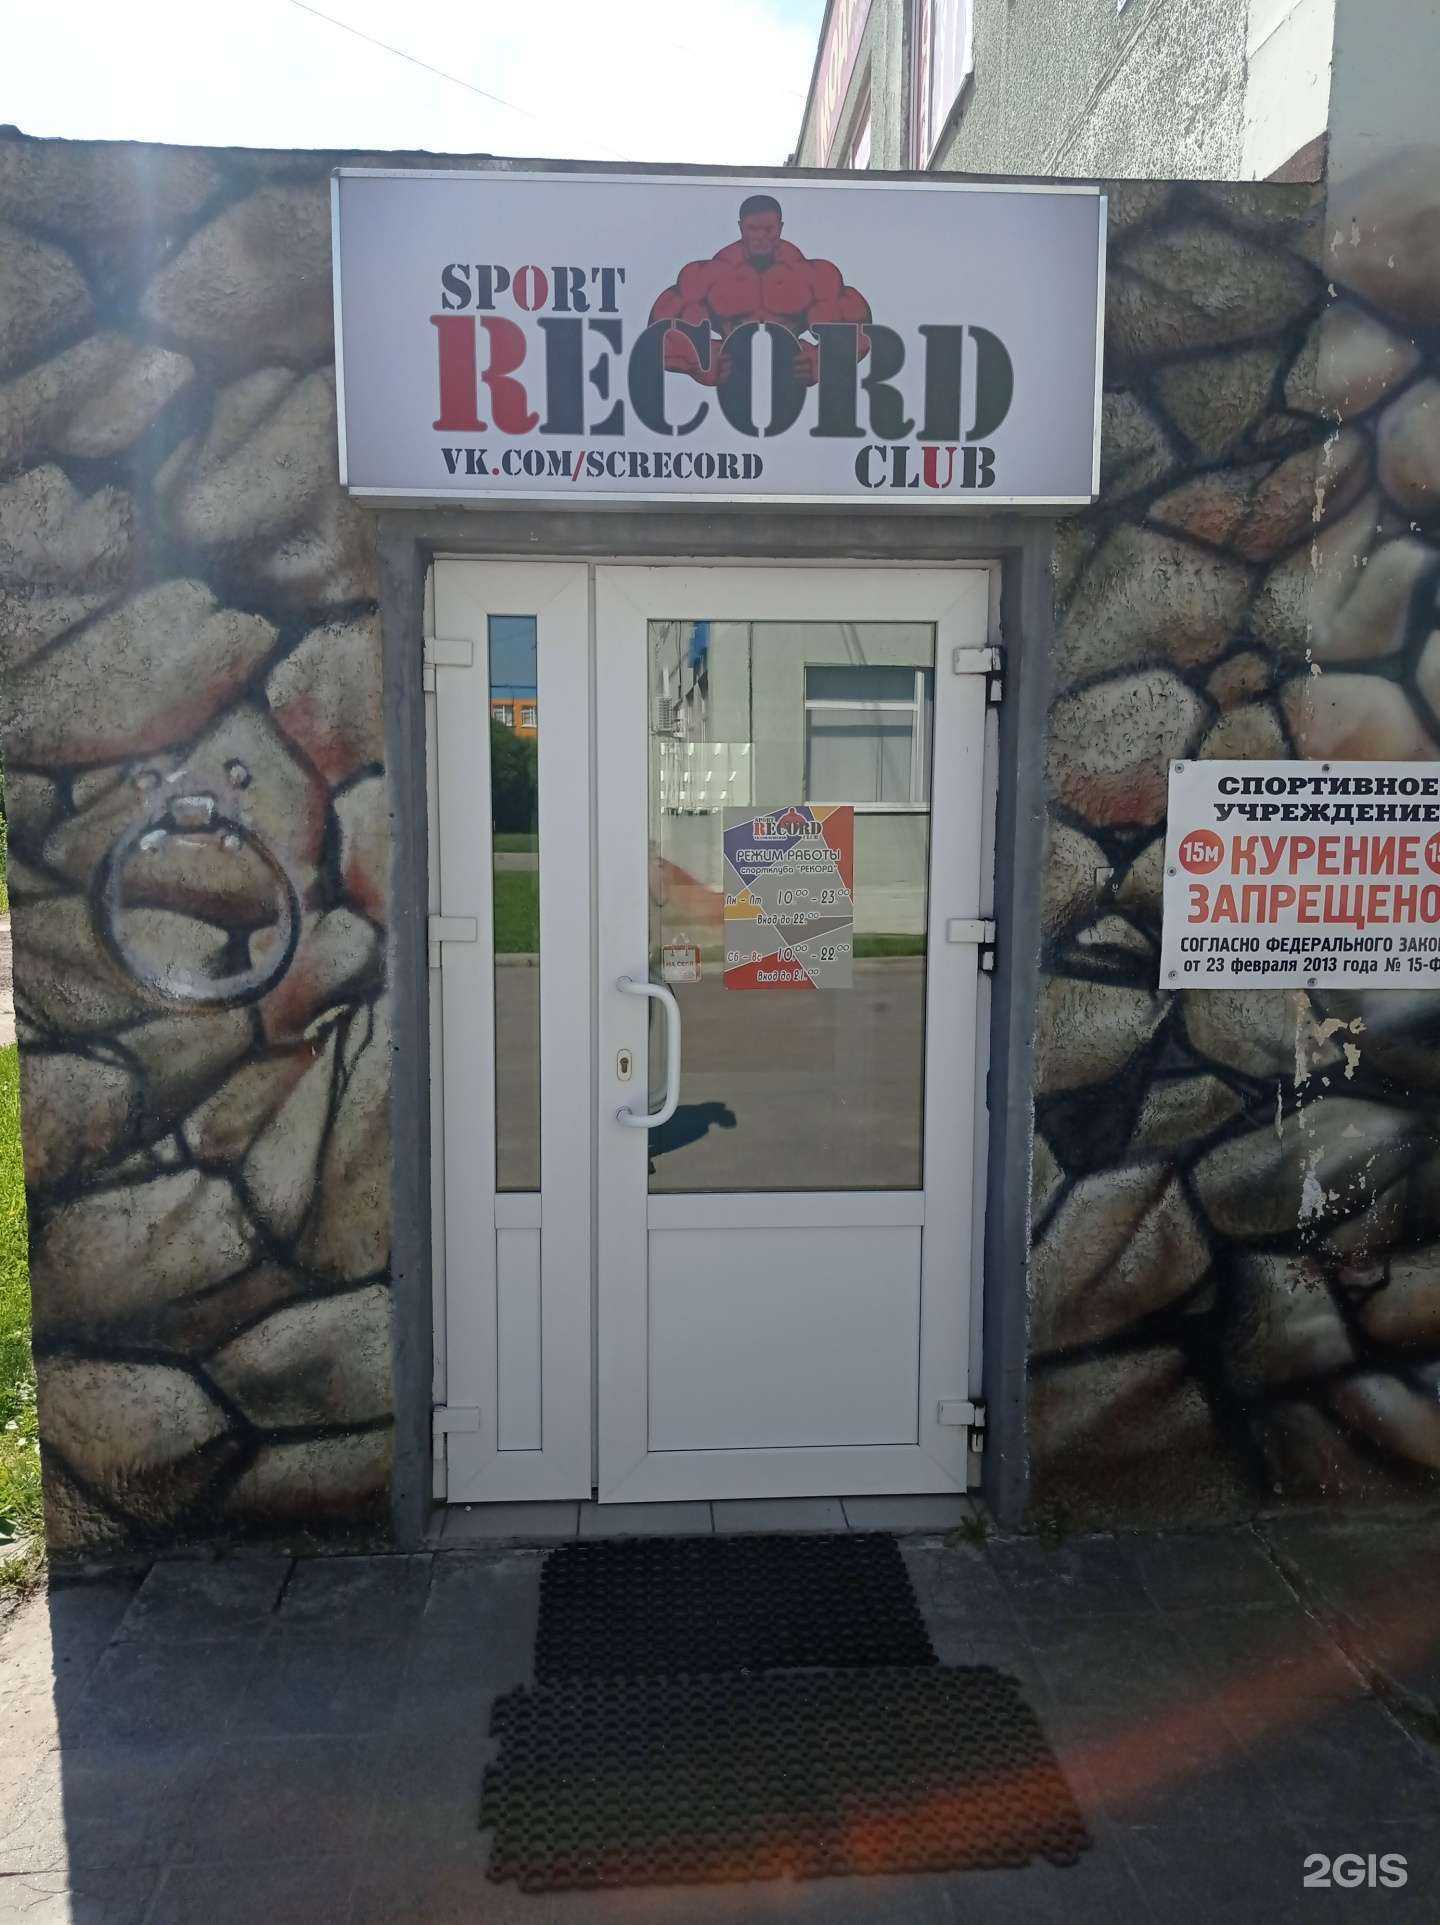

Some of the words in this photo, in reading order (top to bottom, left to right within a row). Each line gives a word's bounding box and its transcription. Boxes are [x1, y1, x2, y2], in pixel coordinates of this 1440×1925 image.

[441, 264, 626, 313] SPORT
[430, 315, 1014, 442] RECORD
[441, 448, 763, 481] VK.COM/SCRECORD
[855, 445, 996, 489] CLUB
[1218, 777, 1439, 796] СПОРТИВНОЕ
[1213, 803, 1440, 825] УЧРЕЖДЕНИЕ
[754, 822, 822, 836] RECORD
[737, 849, 783, 861] РЕЖИМ
[787, 849, 840, 861] РАБОТЫ
[1230, 836, 1421, 876] КУРЕНИЕ
[741, 866, 793, 875] спортклуба
[1187, 884, 1440, 930] ЗАПРЕЩЕНО
[1180, 937, 1259, 952] СОГЛАСНО
[1266, 937, 1393, 954] ФЕДЕРАЛЬНОГО
[1399, 937, 1440, 952] ЗАКО
[1184, 960, 1201, 972] от
[1206, 958, 1224, 972] 23
[1231, 957, 1297, 975] февраля
[1303, 957, 1336, 972] 2013
[1343, 960, 1378, 974] года
[1384, 957, 1400, 972] №
